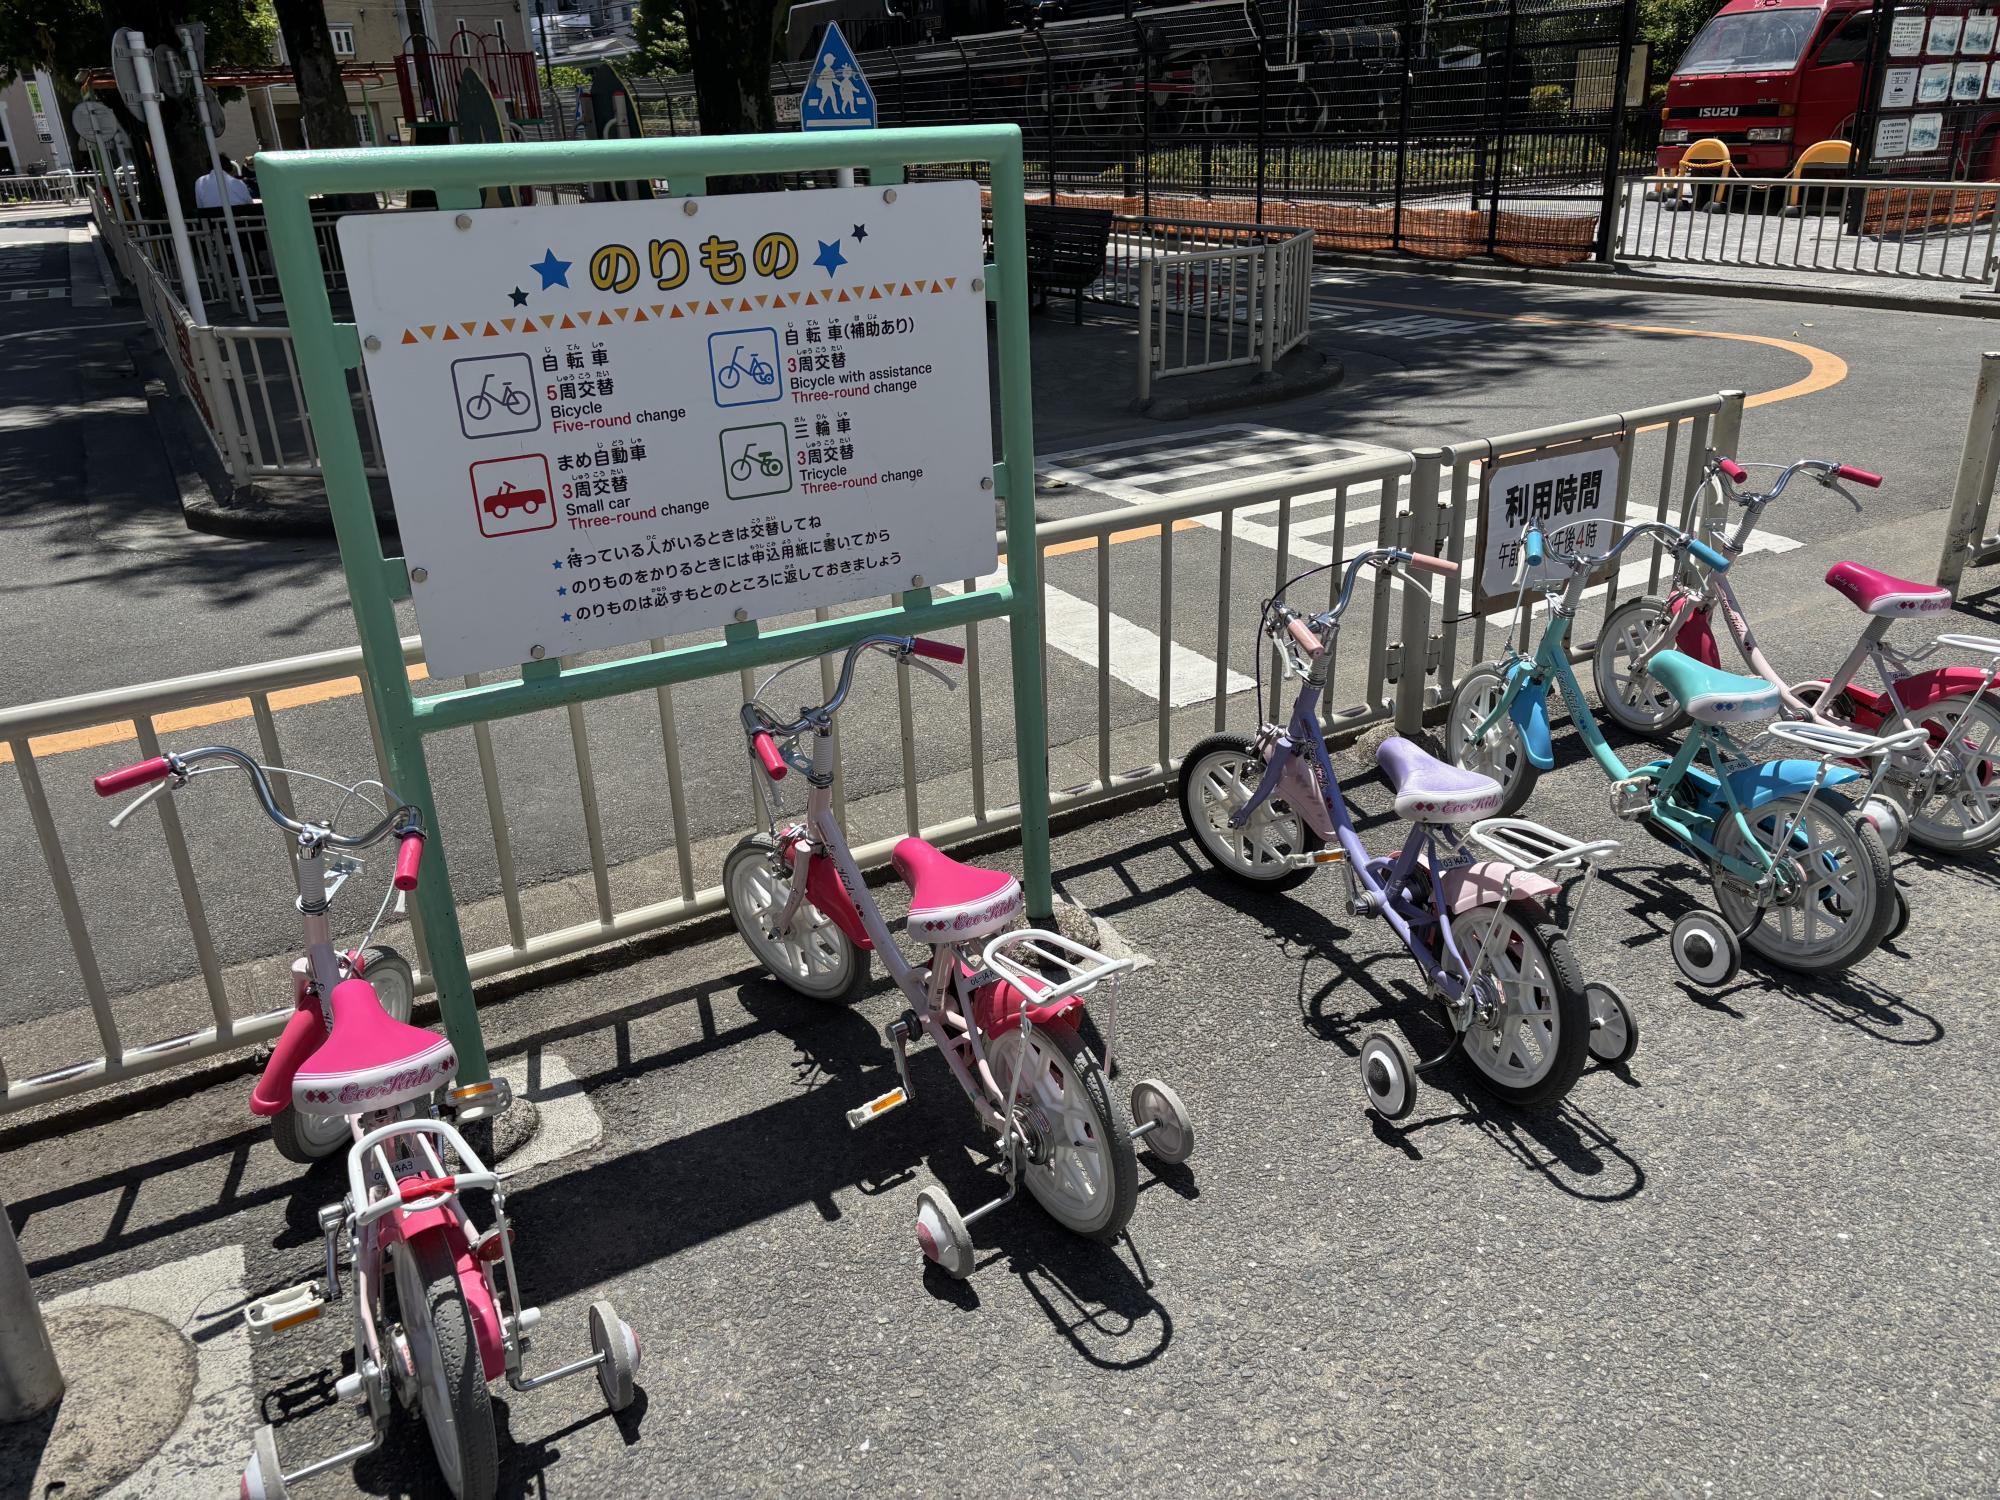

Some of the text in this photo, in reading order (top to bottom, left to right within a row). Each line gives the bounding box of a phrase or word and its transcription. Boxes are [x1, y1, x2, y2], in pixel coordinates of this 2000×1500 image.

[1699, 107, 1739, 117] ISUZU
[590, 232, 799, 294] のりもの
[542, 349, 610, 372] 自転車
[787, 352, 847, 373] 3周交替
[790, 363, 932, 390] Bicycle with assistance
[546, 378, 614, 401] 5周交替
[792, 379, 917, 404] Three-round change
[551, 401, 603, 420] Bicycle
[553, 407, 686, 434] Five-round change
[794, 418, 852, 439] 三輪車
[557, 444, 647, 472] まめ自動車
[797, 444, 855, 466] 3周交替
[799, 465, 847, 482] Tricycle
[801, 468, 923, 495] Three-round change
[562, 475, 628, 499] 3周交替
[1505, 470, 1603, 528] 利用時間
[566, 497, 631, 516] Small car
[568, 500, 710, 530] Three-round change
[567, 515, 822, 569] 待っている人がいるときは交替してね
[572, 529, 890, 594] のりものをかりるときには申込用紙に書いてから
[576, 551, 901, 620] のりものは必ずもとのところに返しておきましょう
